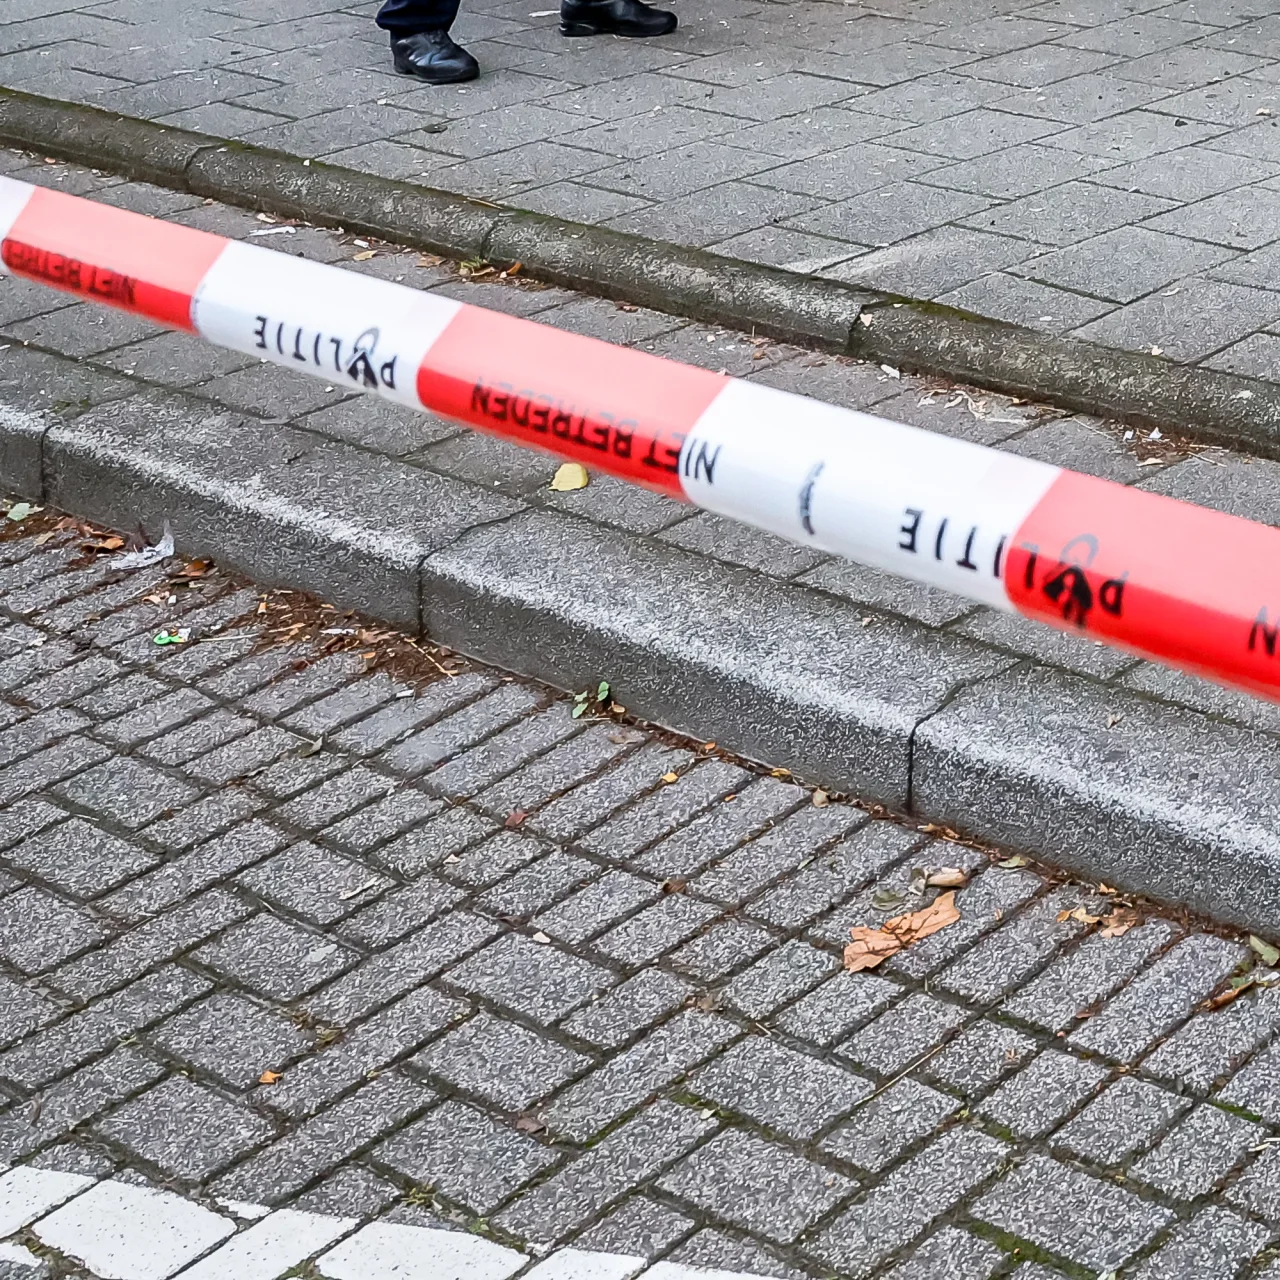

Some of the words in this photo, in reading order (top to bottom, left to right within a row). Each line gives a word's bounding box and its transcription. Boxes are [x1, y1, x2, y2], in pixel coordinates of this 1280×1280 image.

[254, 315, 398, 390] POLITIE
[471, 376, 638, 459] BETREDEN
[641, 428, 723, 486] NIET
[898, 507, 1130, 626] POLITIE
